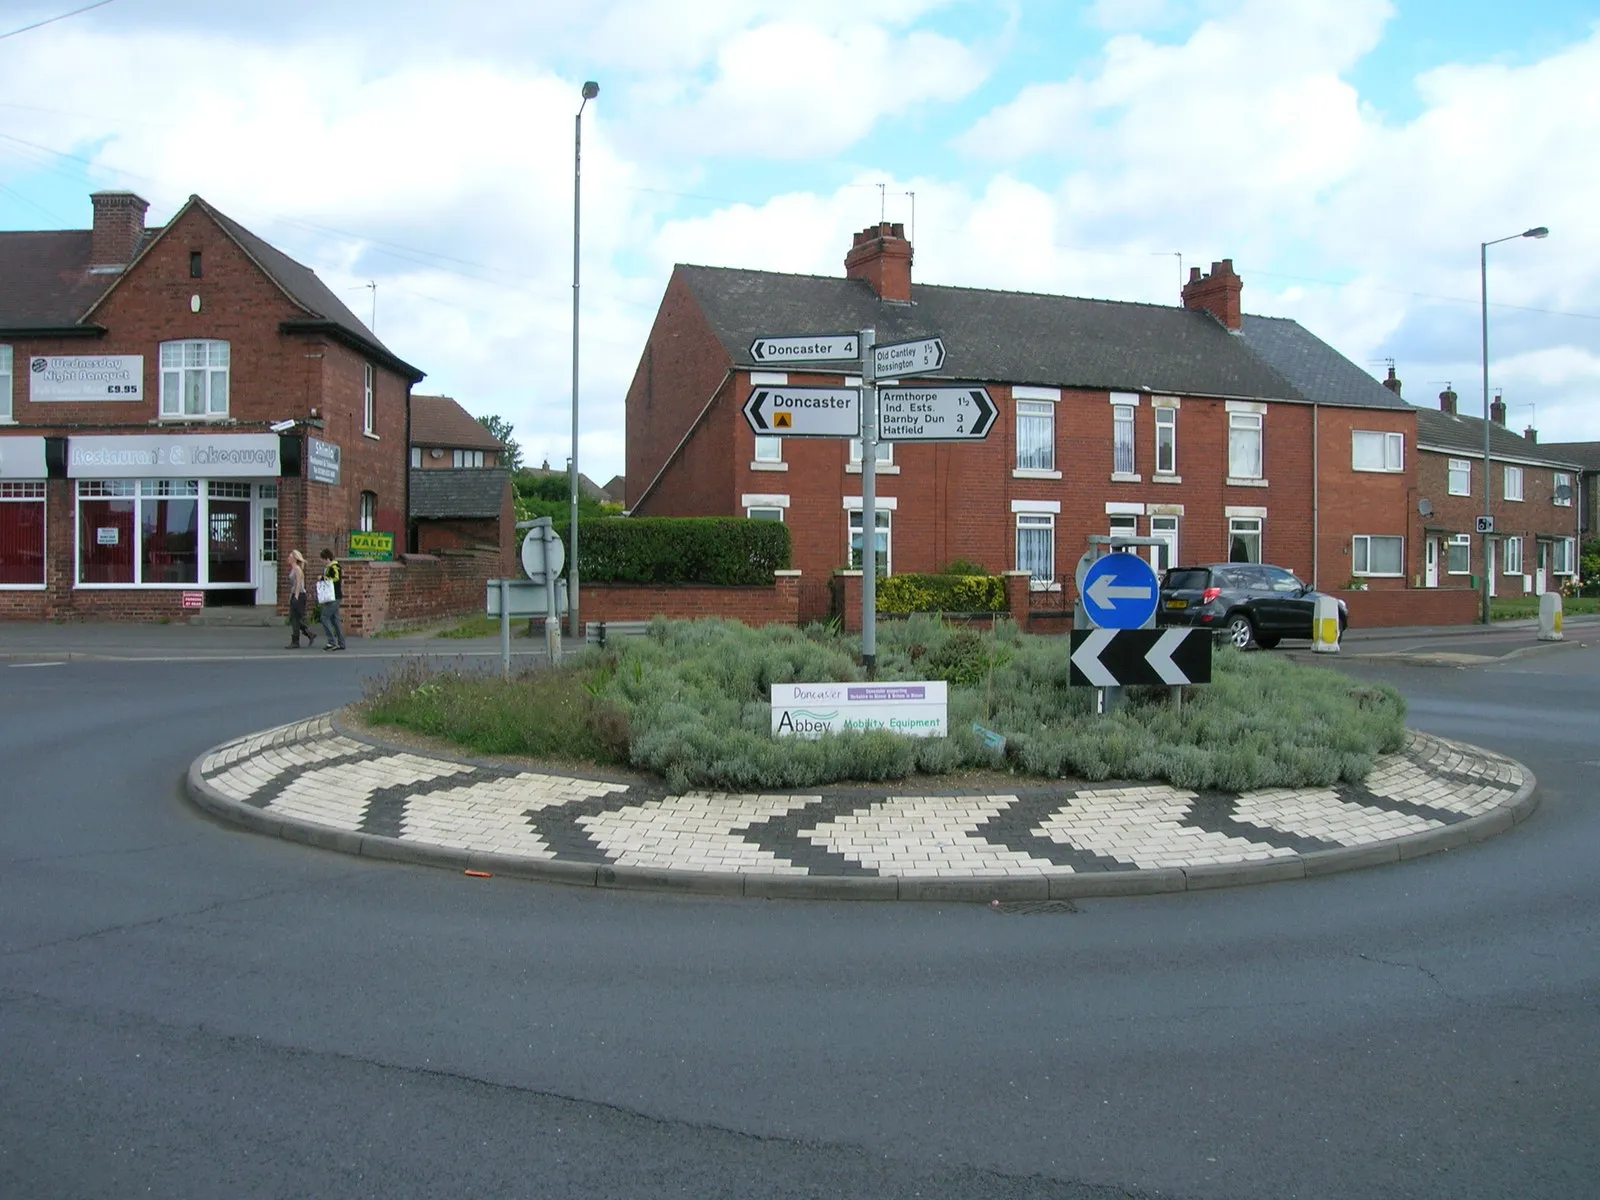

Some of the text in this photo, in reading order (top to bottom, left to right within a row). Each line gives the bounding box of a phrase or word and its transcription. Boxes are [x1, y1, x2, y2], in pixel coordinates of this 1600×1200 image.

[768, 342, 852, 355] Doncaster 4
[877, 351, 889, 361] Old
[890, 347, 916, 360] Cantley
[52, 358, 122, 370] Wednesday
[877, 356, 929, 372] Rossington 5
[44, 369, 130, 383] Night Banquet
[107, 385, 138, 394] £9.95
[774, 394, 851, 409] Doncaster
[883, 392, 938, 402] Armthorpe
[885, 403, 936, 413] Ind. Ests.
[883, 413, 964, 425] Barnby Dun 3
[883, 425, 964, 435] Hatfield 4
[72, 444, 277, 468] Restaurant & Takeaway
[353, 537, 391, 549] VALET
[793, 686, 842, 700] Doncaster
[777, 711, 831, 734] Abbey
[843, 718, 941, 729] Mobility Equipment
